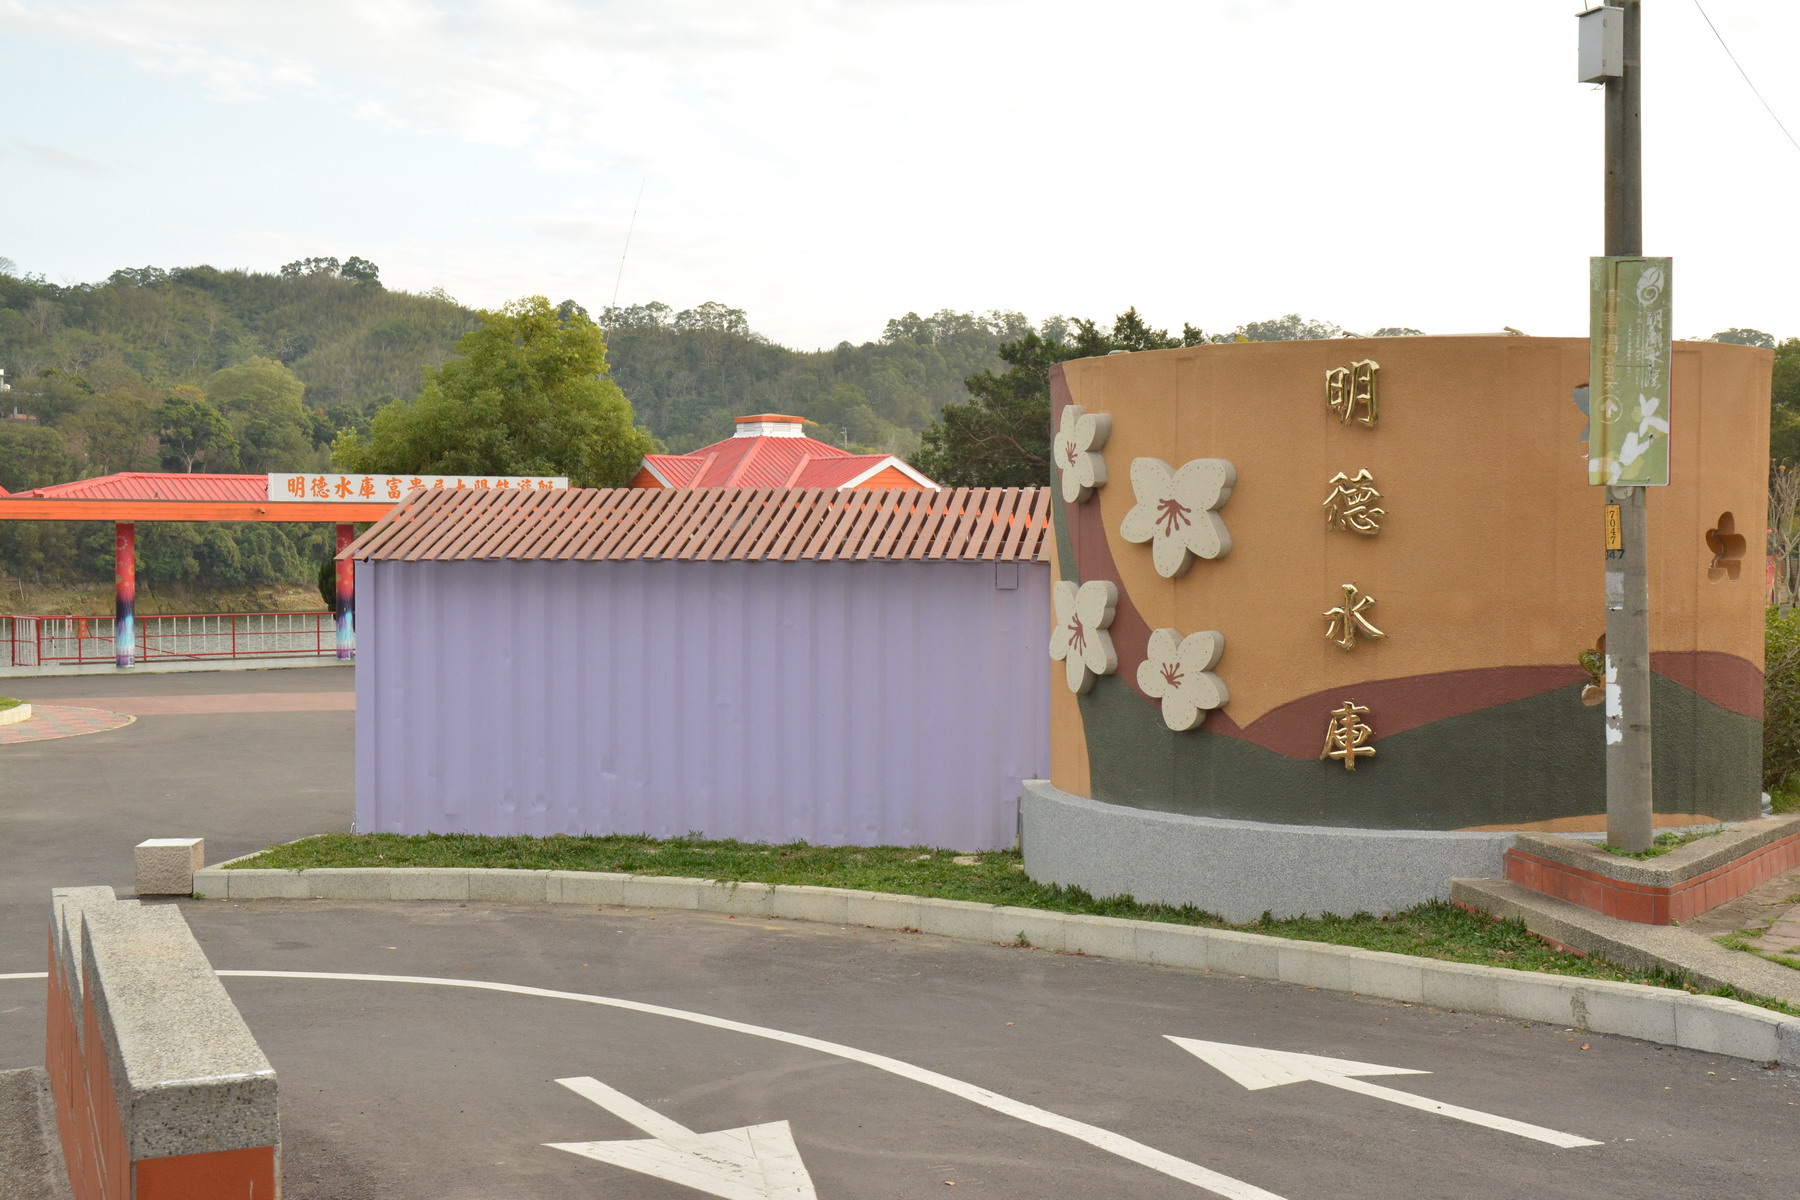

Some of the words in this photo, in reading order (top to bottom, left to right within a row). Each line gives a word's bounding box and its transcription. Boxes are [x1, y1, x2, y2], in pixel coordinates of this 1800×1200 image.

[287, 476, 376, 499] 明德水庫
[1320, 358, 1389, 772] 明德水庫
